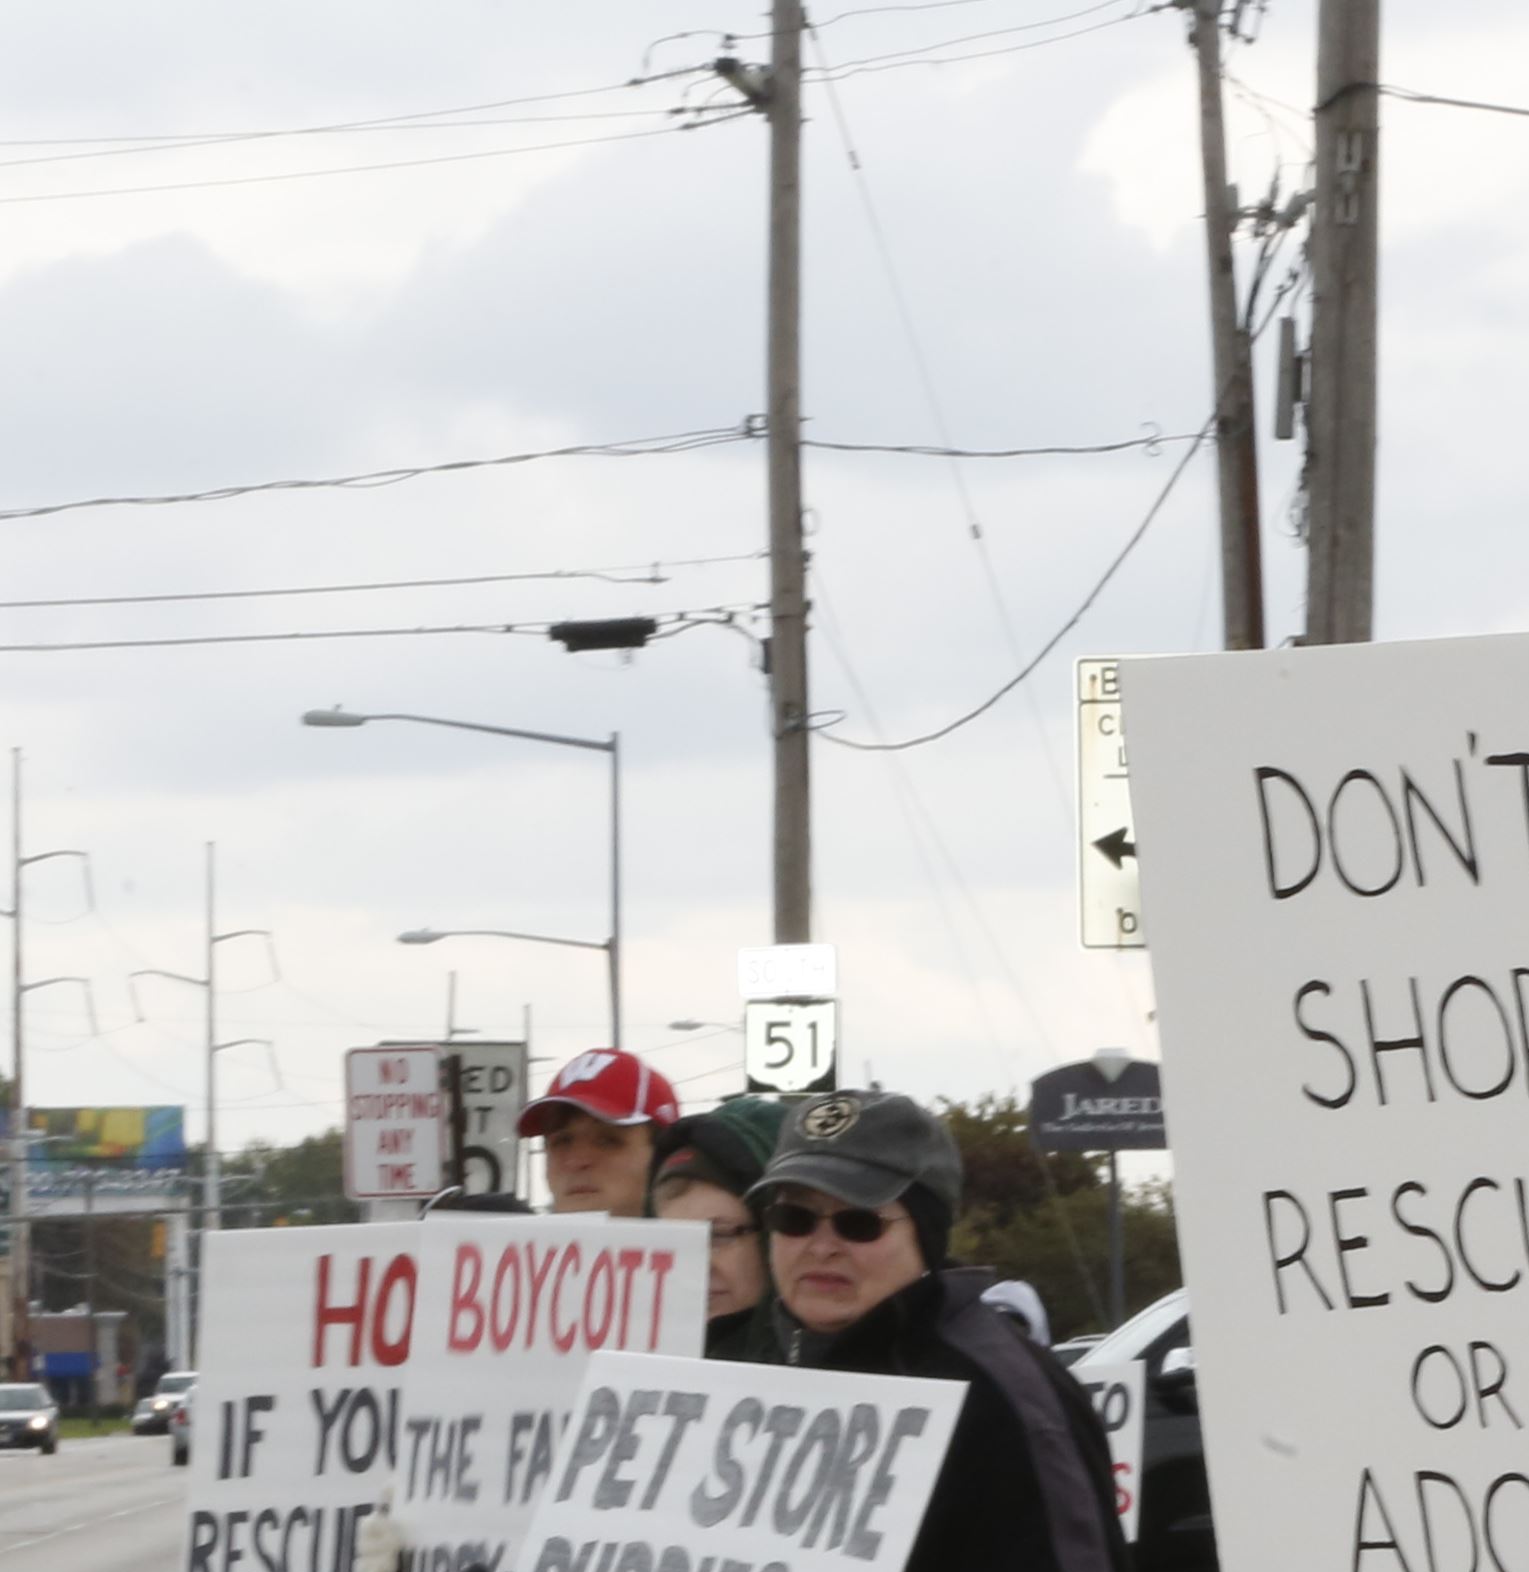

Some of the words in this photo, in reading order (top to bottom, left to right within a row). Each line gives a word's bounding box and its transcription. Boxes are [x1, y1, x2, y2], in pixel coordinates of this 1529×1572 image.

[379, 1058, 410, 1084] NO
[764, 1021, 820, 1069] 51
[351, 1094, 441, 1120] STOPPING
[376, 1129, 416, 1154] ANY
[377, 1163, 416, 1190] TIME
[447, 1242, 674, 1356] BOYCOTT
[1411, 1340, 1523, 1430] OR
[217, 1395, 274, 1479] IF
[405, 1414, 482, 1504] THE
[555, 1386, 709, 1510] PET
[690, 1398, 929, 1561] STORE
